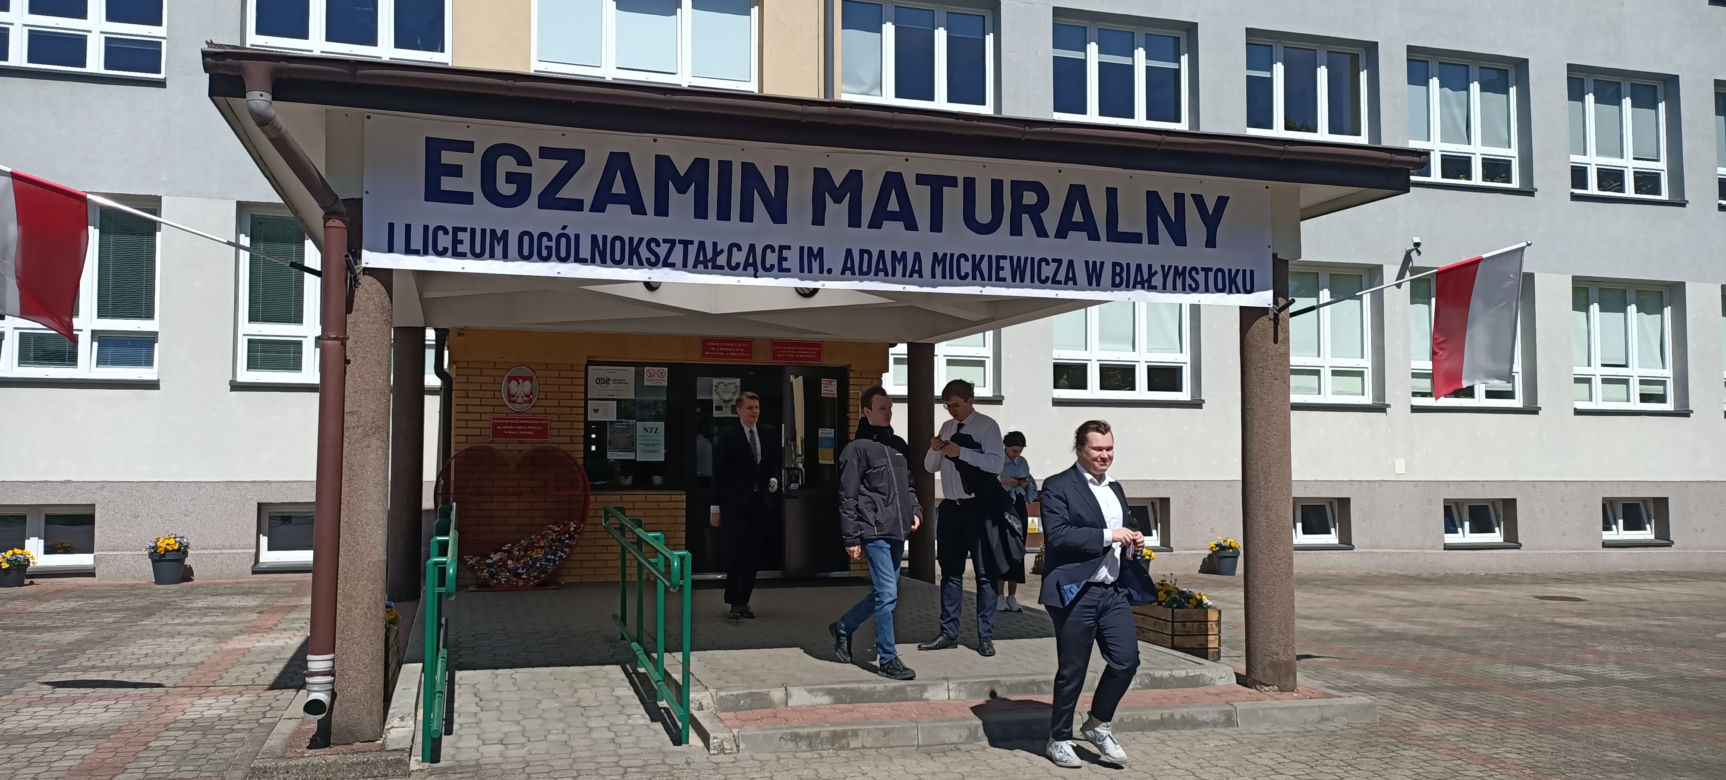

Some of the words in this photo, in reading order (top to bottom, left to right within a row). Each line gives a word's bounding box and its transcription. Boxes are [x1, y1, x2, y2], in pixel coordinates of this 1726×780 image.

[423, 135, 789, 225] EGZAMIN
[810, 166, 1231, 249] MATURALNY
[385, 221, 396, 254] I
[403, 222, 509, 260] LICEUM
[517, 225, 793, 279] OGÓLNOKSZTAŁCĄCE
[798, 245, 833, 276] IM.
[840, 247, 924, 280] ADAMA
[930, 251, 1079, 288] MICKIEWICZA
[1084, 259, 1106, 288] W
[1110, 261, 1256, 296] BIAŁYMSTOKU
